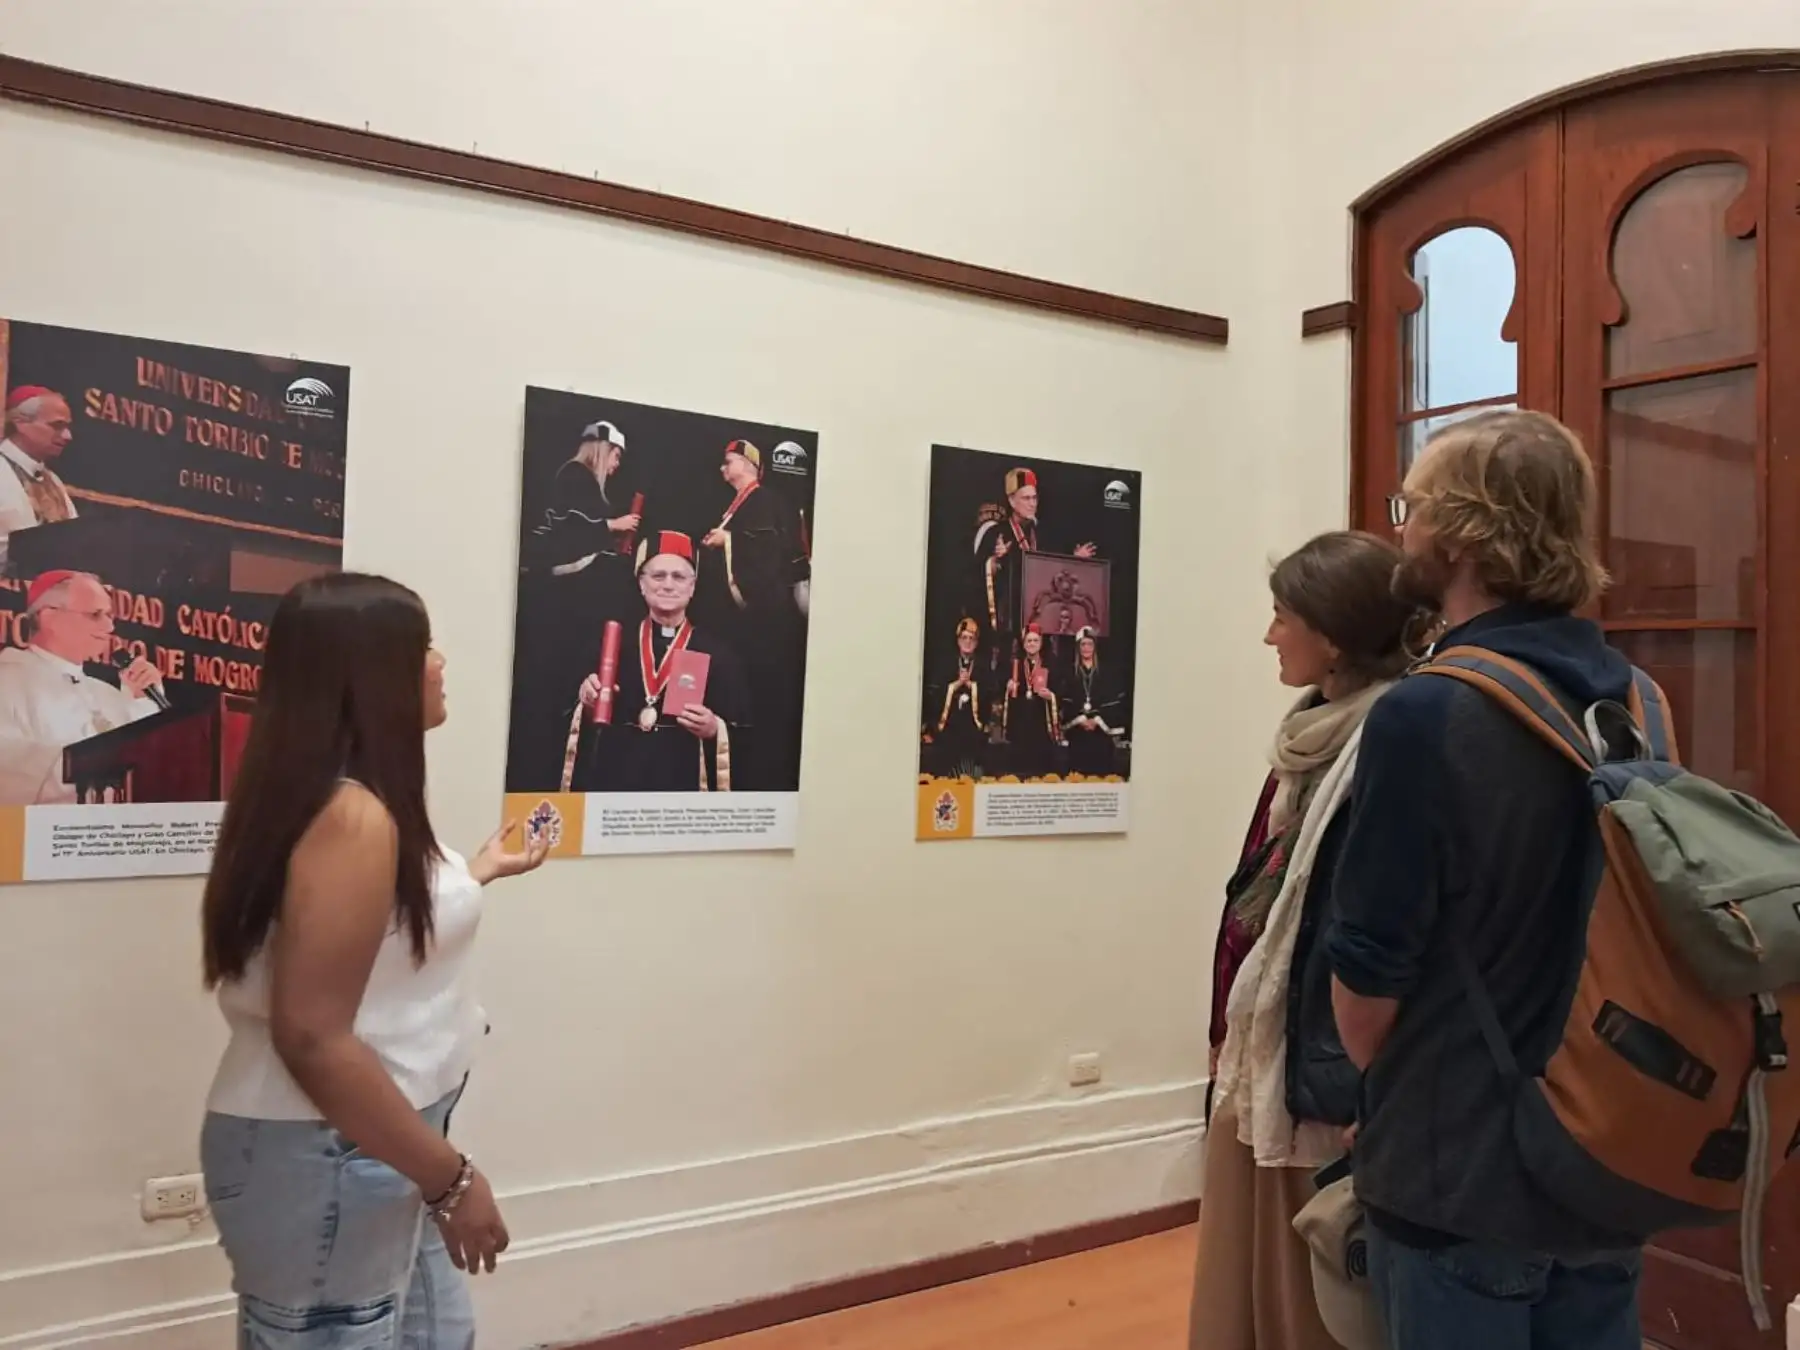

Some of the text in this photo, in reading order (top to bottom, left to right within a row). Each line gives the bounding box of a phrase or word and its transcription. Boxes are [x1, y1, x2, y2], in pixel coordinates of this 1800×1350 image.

[286, 391, 319, 406] USAT
[84, 387, 173, 436] SANTO
[773, 453, 797, 466] USAT
[156, 646, 184, 681] DE
